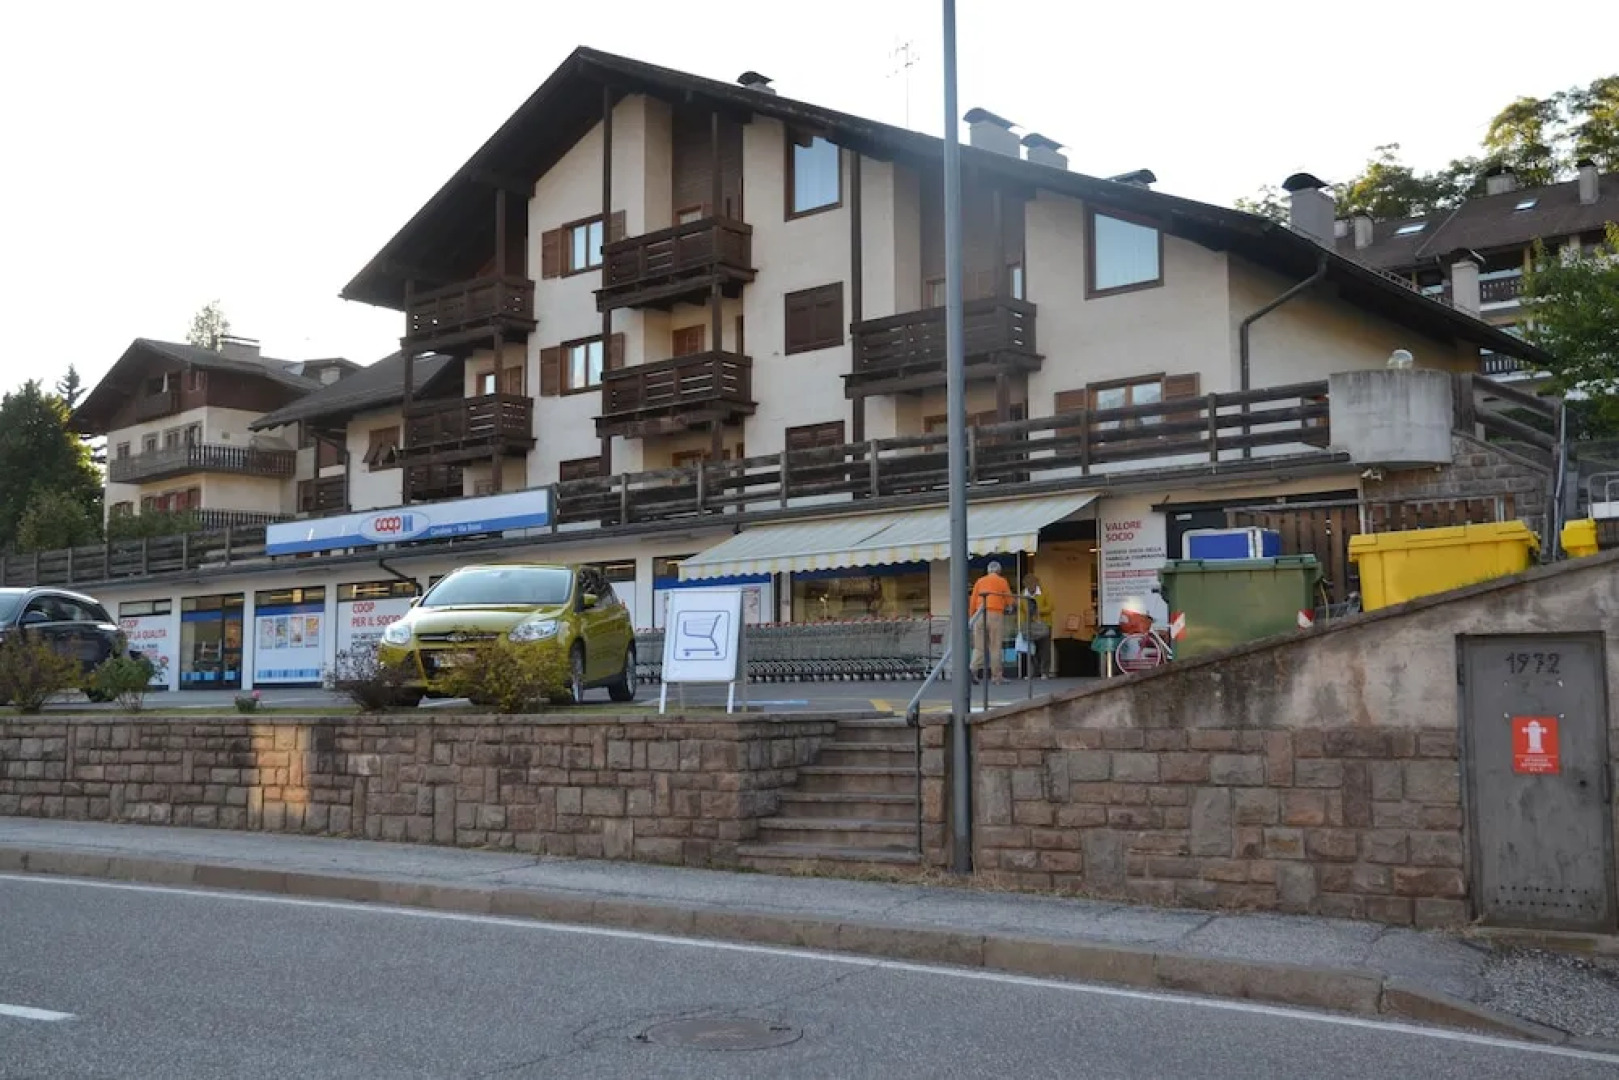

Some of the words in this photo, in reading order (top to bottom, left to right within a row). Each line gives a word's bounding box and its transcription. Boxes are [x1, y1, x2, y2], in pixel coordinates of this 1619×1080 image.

[375, 516, 400, 534] coop
[1105, 521, 1142, 531] VALORE
[1105, 532, 1134, 542] SOCIO
[353, 602, 375, 613] COOP
[352, 617, 366, 627] PER
[368, 616, 375, 626] IL
[1505, 652, 1560, 674] 1972
